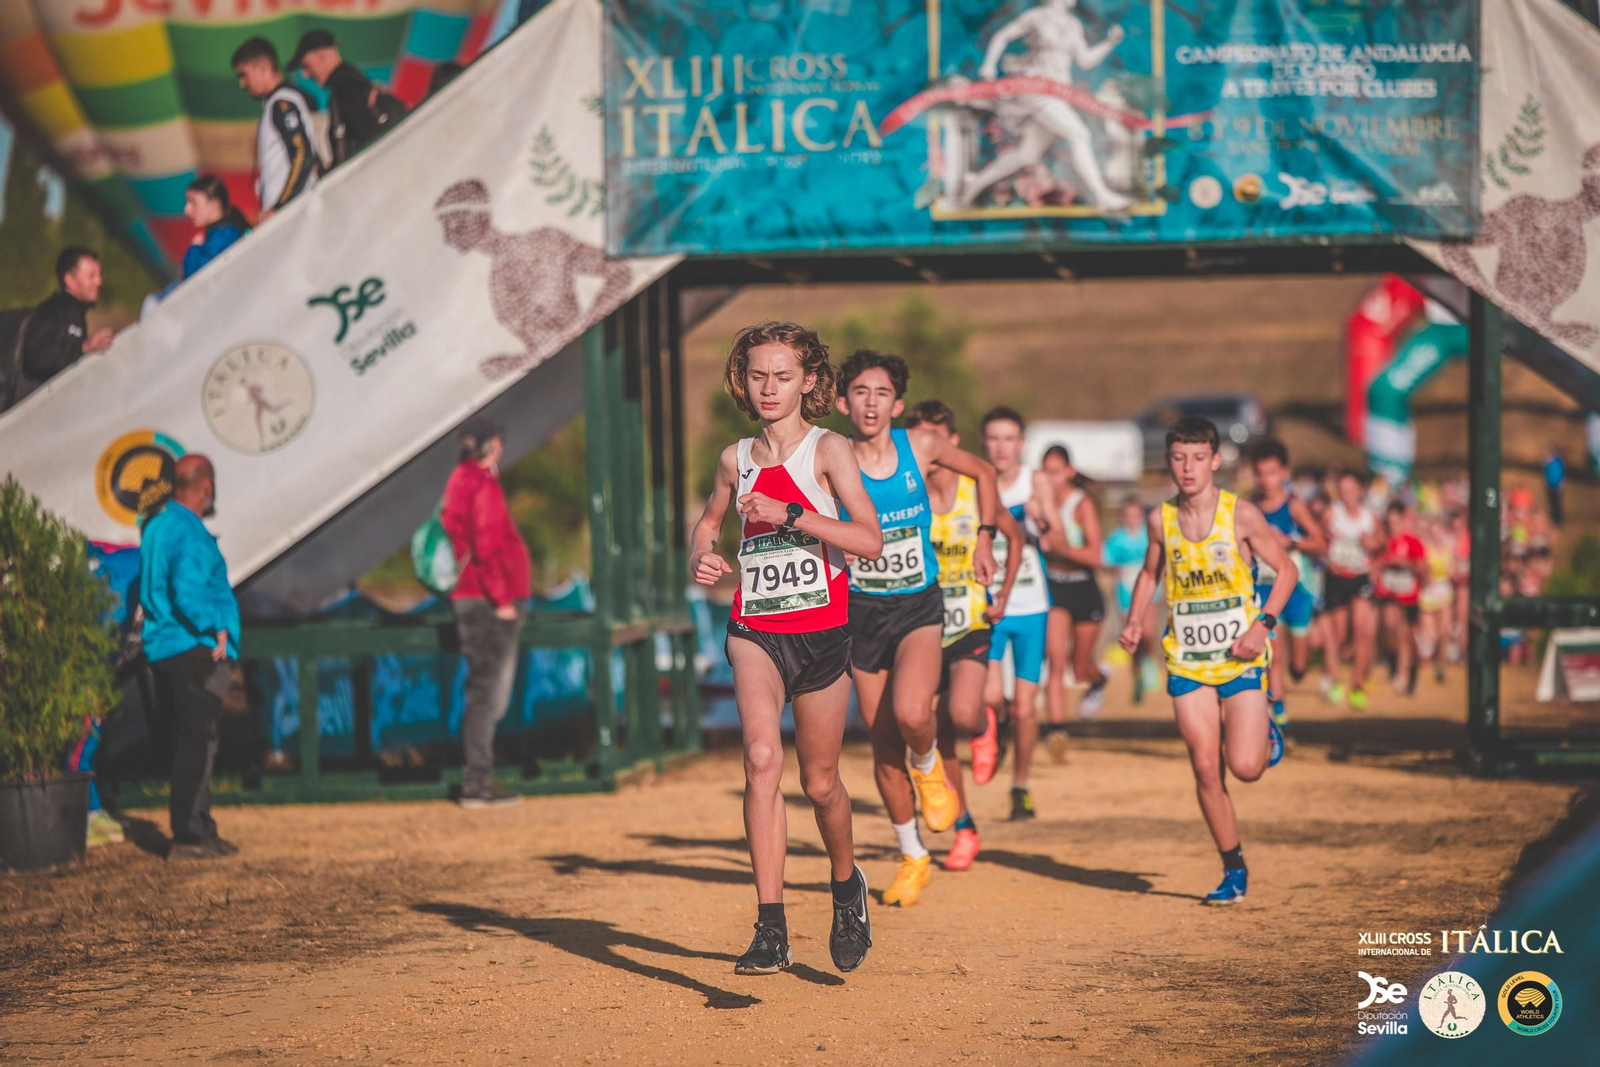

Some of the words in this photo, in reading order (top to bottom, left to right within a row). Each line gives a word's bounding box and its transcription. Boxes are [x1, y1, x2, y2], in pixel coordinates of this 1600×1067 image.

[1175, 42, 1318, 64] CAMPEONATO
[1319, 42, 1347, 63] DE
[744, 52, 848, 82] CROSS
[1299, 62, 1377, 81] CAMPO
[1221, 79, 1240, 98] A
[1318, 79, 1361, 98] POR
[1362, 78, 1438, 98] CLUBES
[1298, 114, 1462, 141] NOVIEMBRE
[351, 320, 417, 376] Sevilla
[858, 548, 919, 573] 8036
[746, 558, 818, 593] 7949
[1183, 620, 1241, 646] 8002
